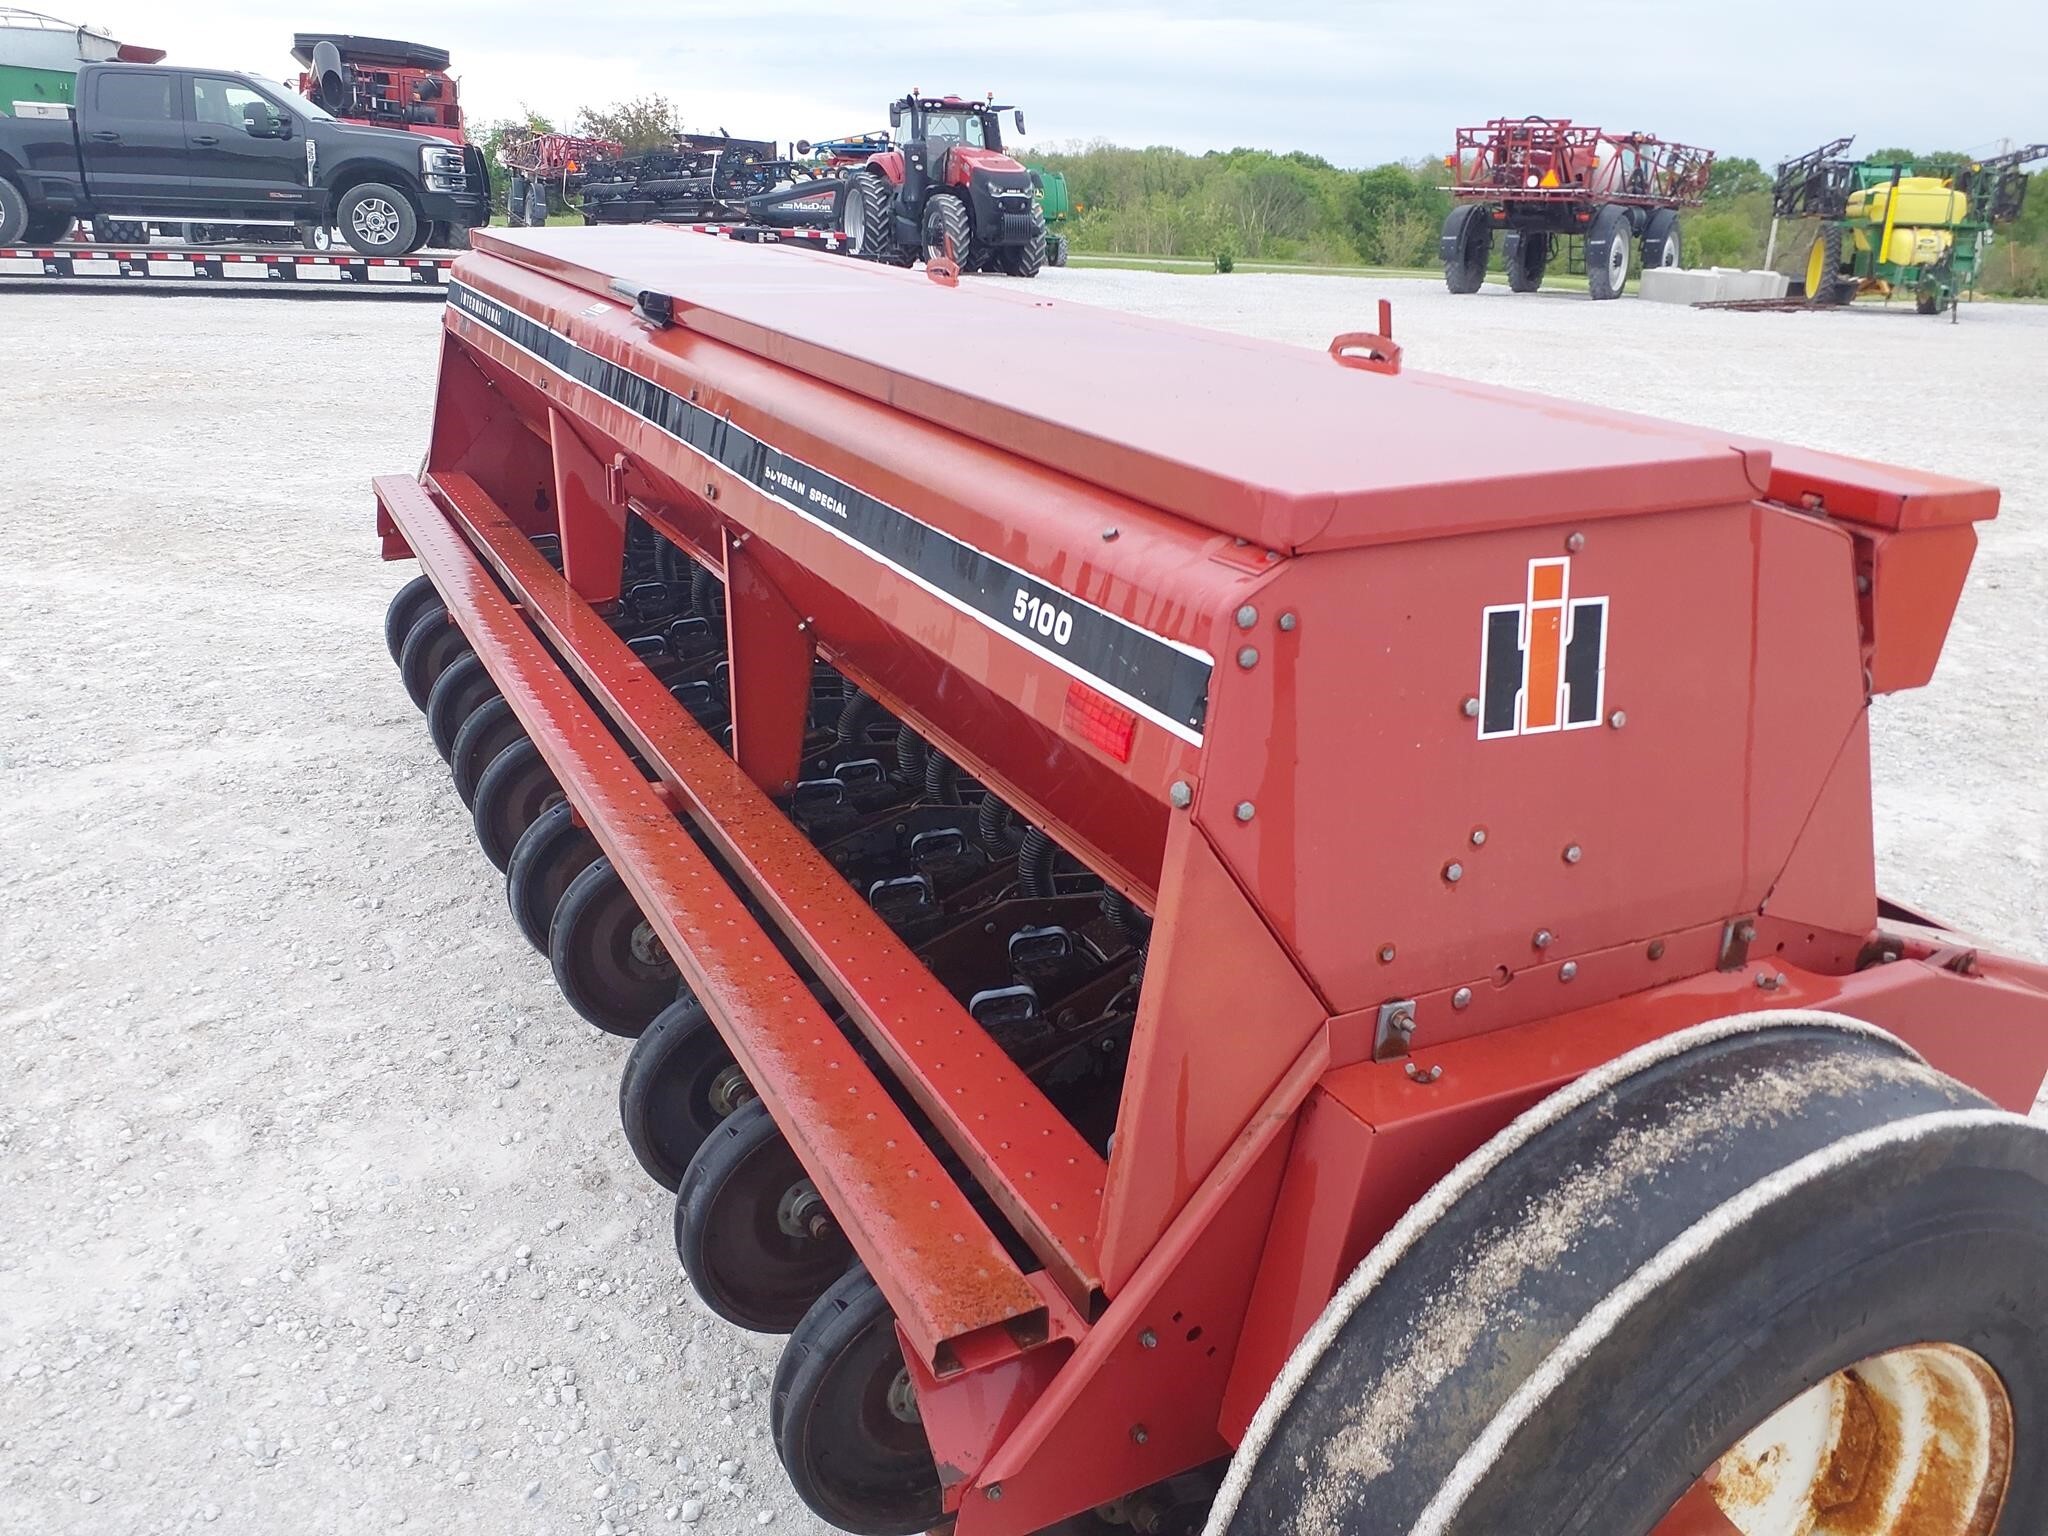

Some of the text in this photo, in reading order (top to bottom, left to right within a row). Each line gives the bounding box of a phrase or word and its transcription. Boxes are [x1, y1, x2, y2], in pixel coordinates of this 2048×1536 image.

[793, 202, 831, 210] MacDon
[460, 290, 502, 326] INTERNATIONAL
[809, 487, 848, 519] SPECIAL
[1012, 588, 1073, 646] 5100
